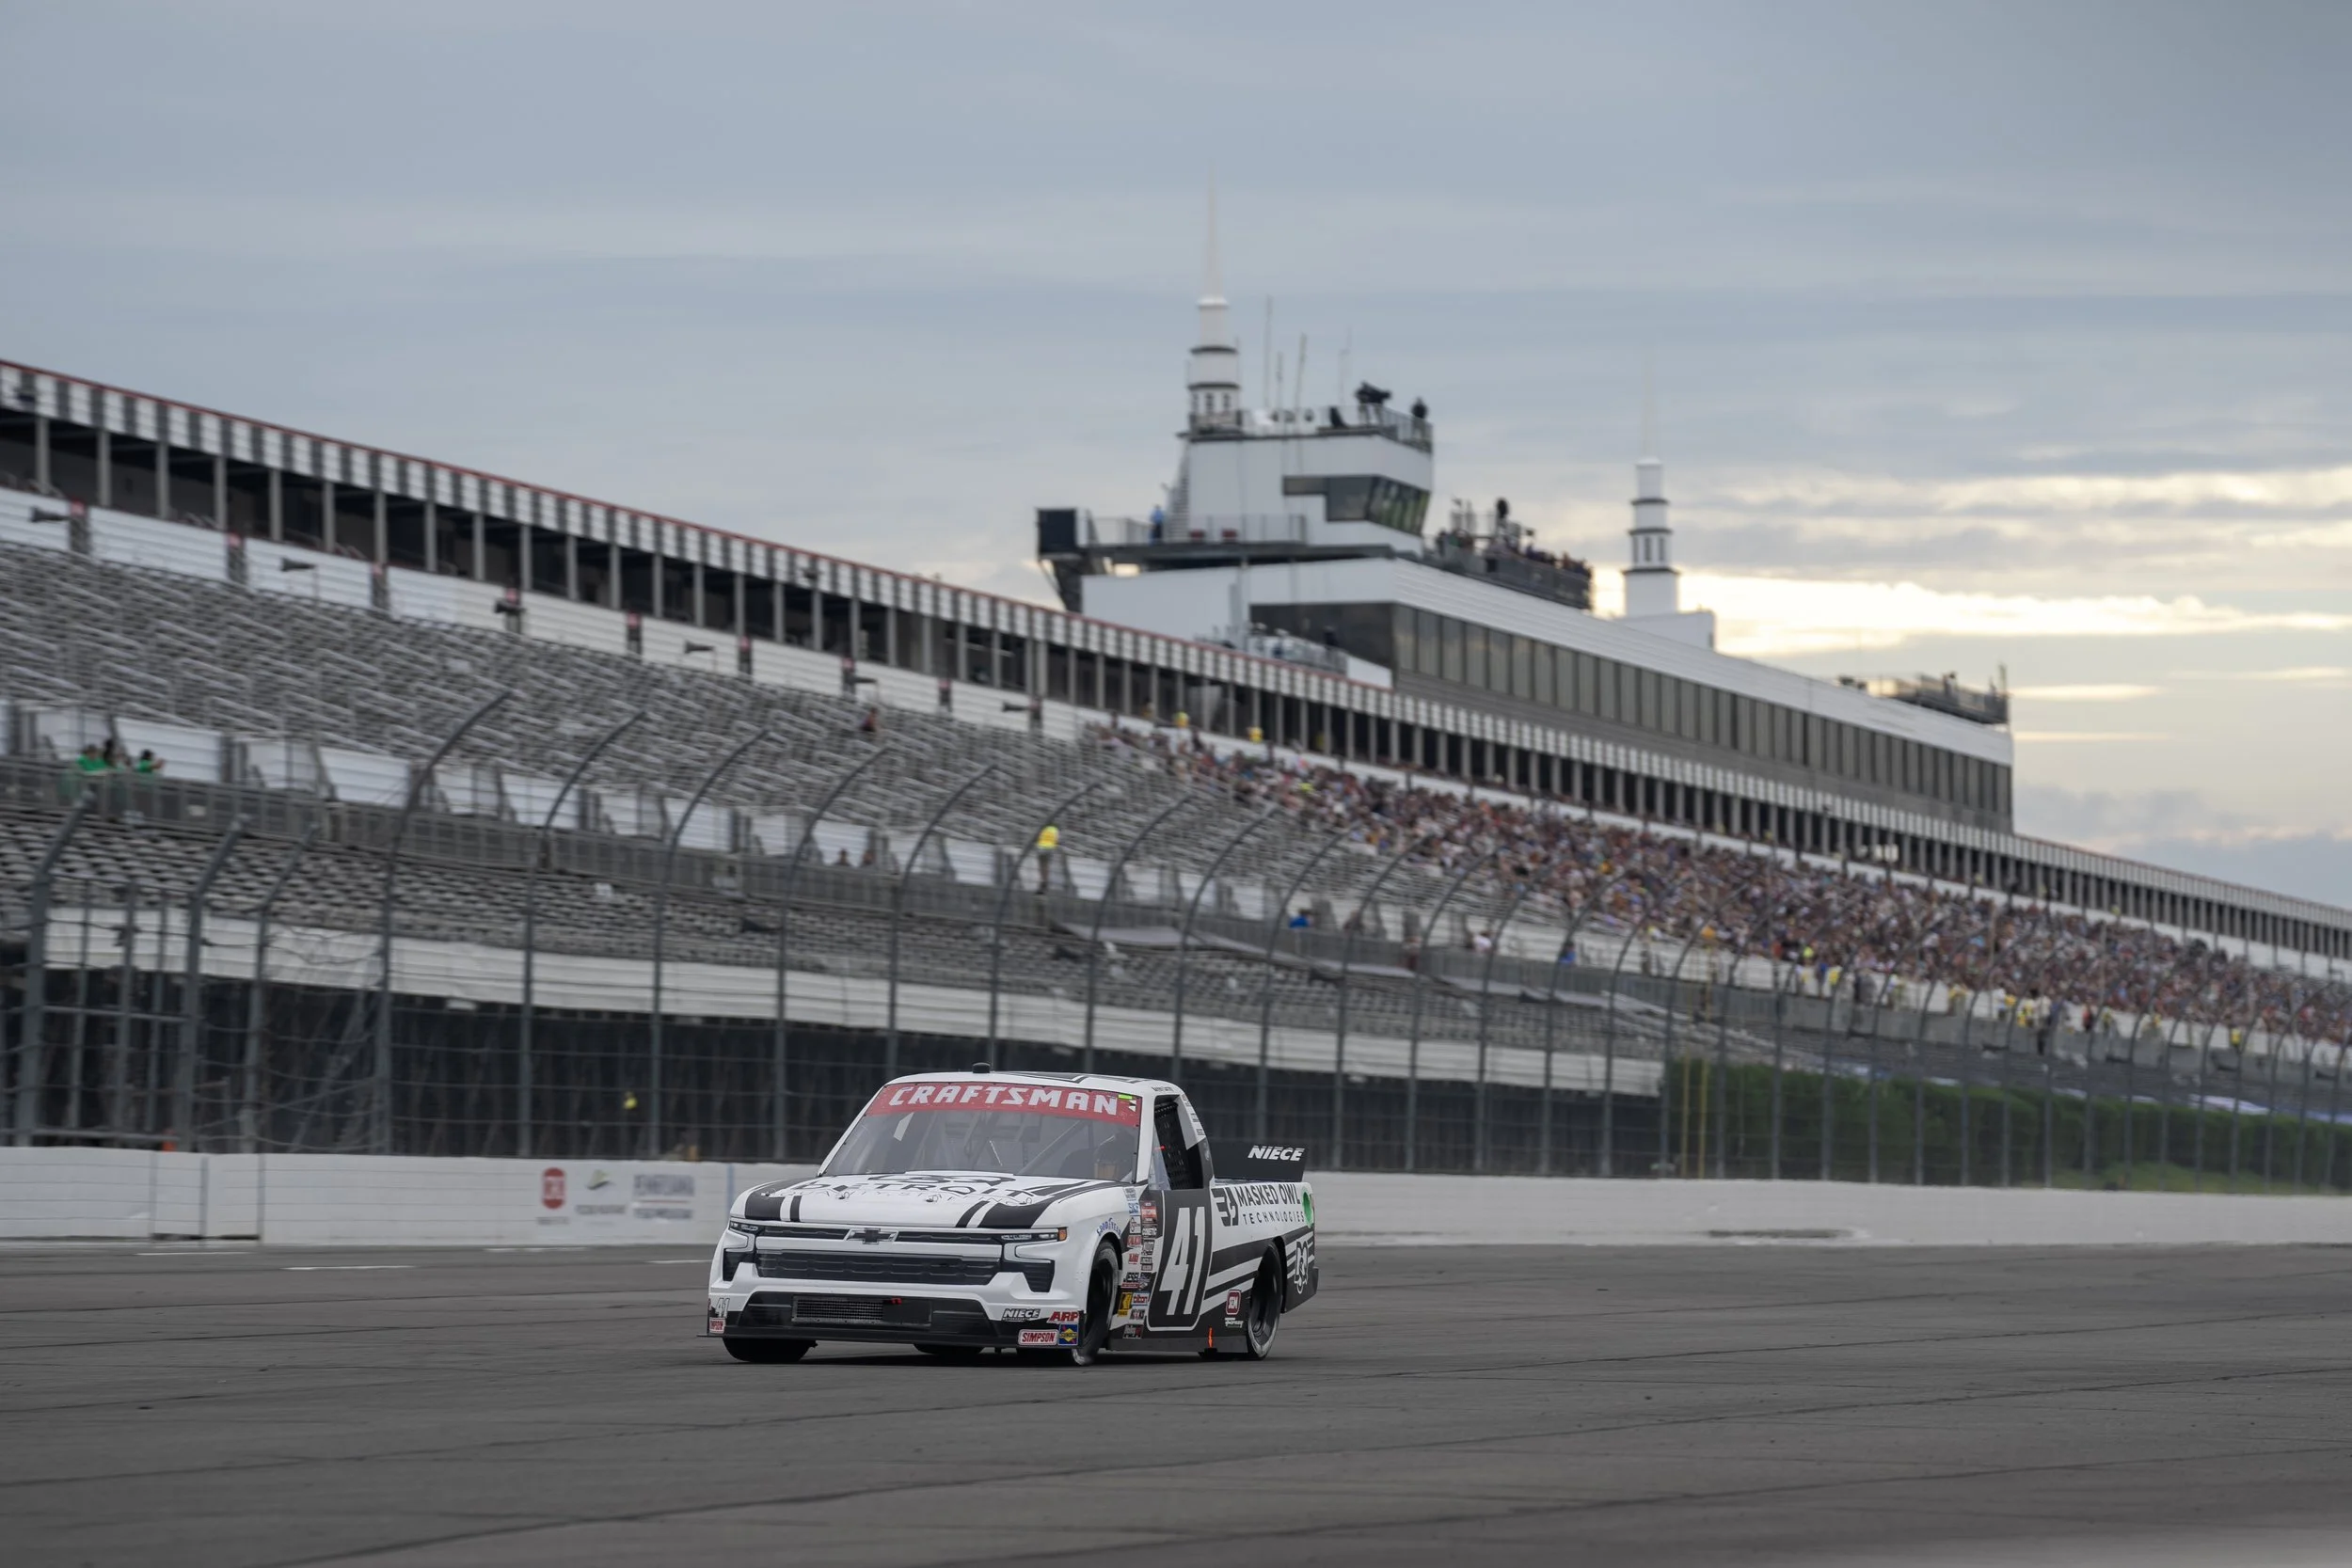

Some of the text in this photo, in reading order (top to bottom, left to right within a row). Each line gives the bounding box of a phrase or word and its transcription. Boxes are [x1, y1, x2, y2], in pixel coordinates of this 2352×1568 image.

[888, 1085, 1118, 1116] CRAFTSMAN
[1248, 1145, 1306, 1162] NIECE
[1234, 1183, 1301, 1207] MASKED OWL
[1243, 1211, 1305, 1226] TECHNOLOGIES
[1159, 1206, 1206, 1316] 41
[715, 1297, 730, 1318] 41
[1003, 1308, 1041, 1319] NIECE
[1049, 1311, 1079, 1323] ARP
[1022, 1332, 1056, 1343] SIMPSON
